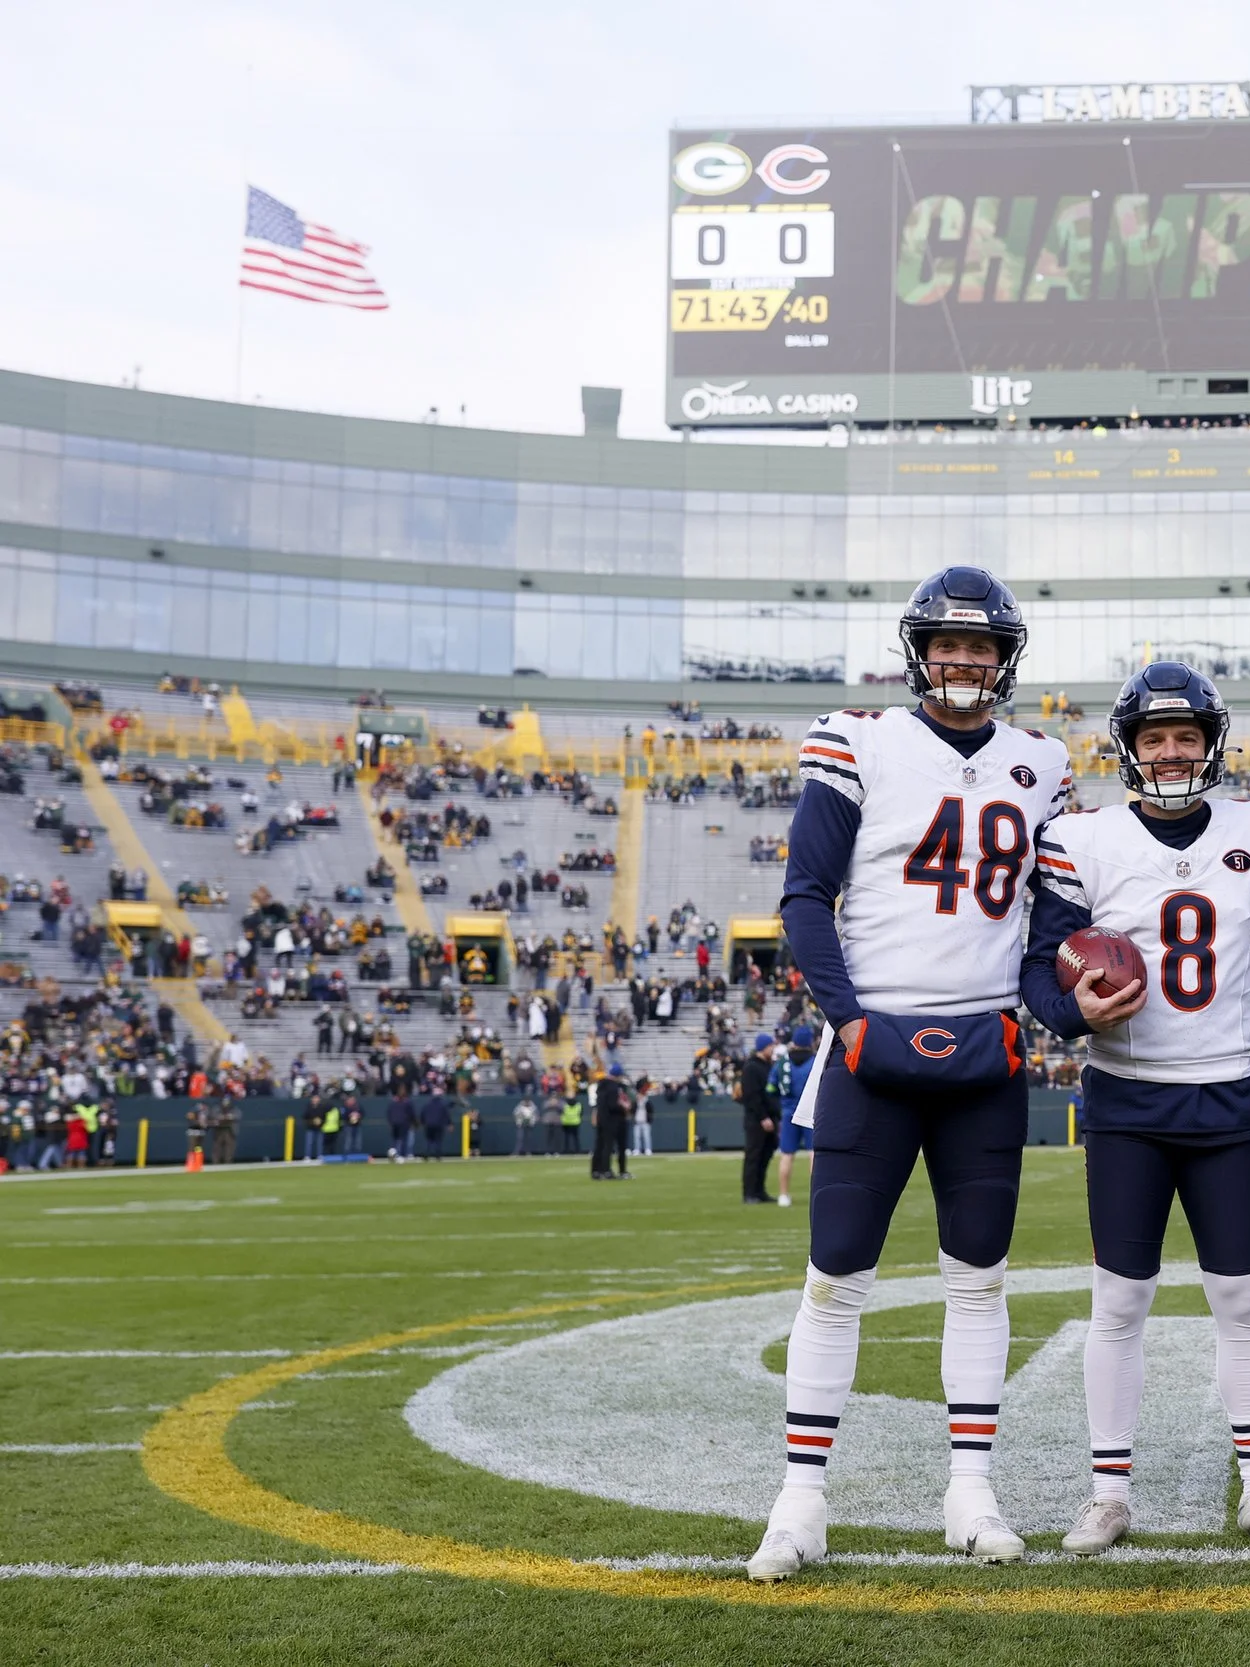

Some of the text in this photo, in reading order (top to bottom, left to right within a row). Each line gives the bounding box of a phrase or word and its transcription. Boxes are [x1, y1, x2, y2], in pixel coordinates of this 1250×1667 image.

[697, 223, 807, 266] 0 0
[678, 296, 769, 324] 71:43
[776, 392, 858, 415] CASINO
[969, 375, 1034, 415] Lite
[1053, 449, 1076, 466] 14
[1167, 448, 1182, 464] 3
[1020, 771, 1030, 787] 51
[903, 796, 1031, 921] 48
[1233, 856, 1245, 870] 51
[1160, 891, 1217, 1013] 8
